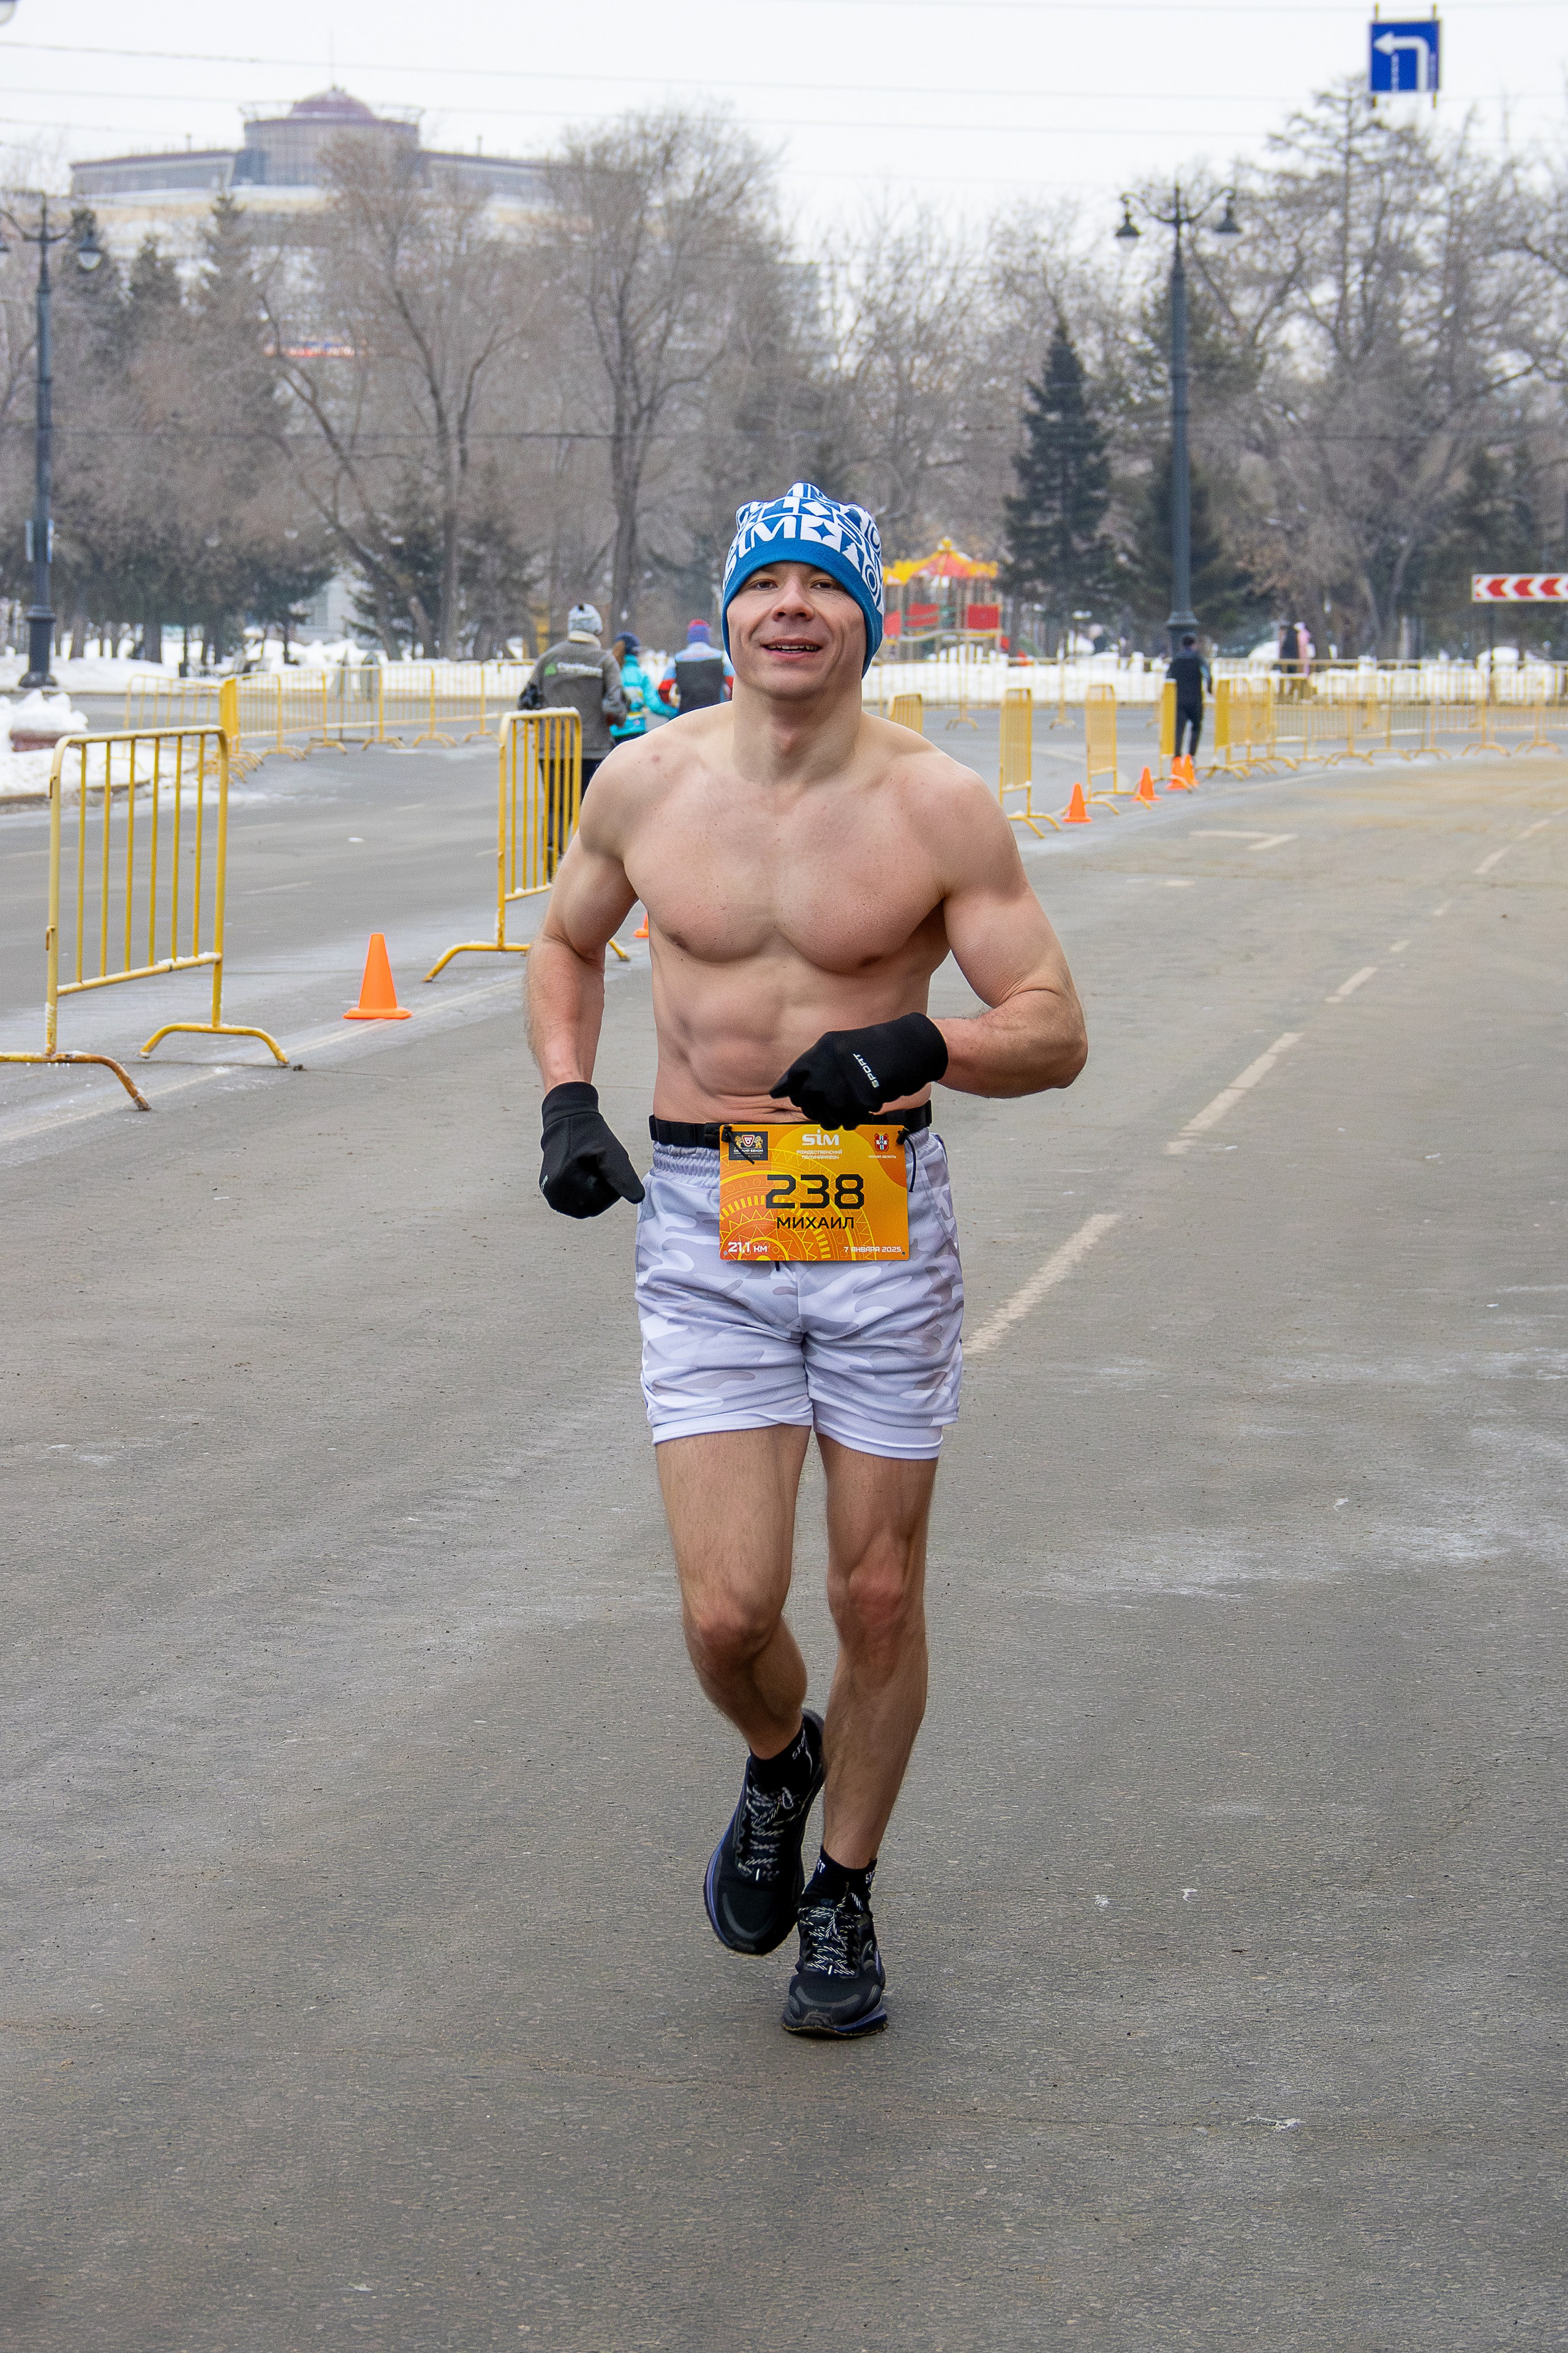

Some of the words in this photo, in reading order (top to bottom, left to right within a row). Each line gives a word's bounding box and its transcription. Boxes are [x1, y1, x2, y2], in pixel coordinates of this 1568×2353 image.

[853, 1053, 880, 1088] SPORT
[766, 1174, 865, 1209] 238
[777, 1217, 854, 1229] МИХАИЛ
